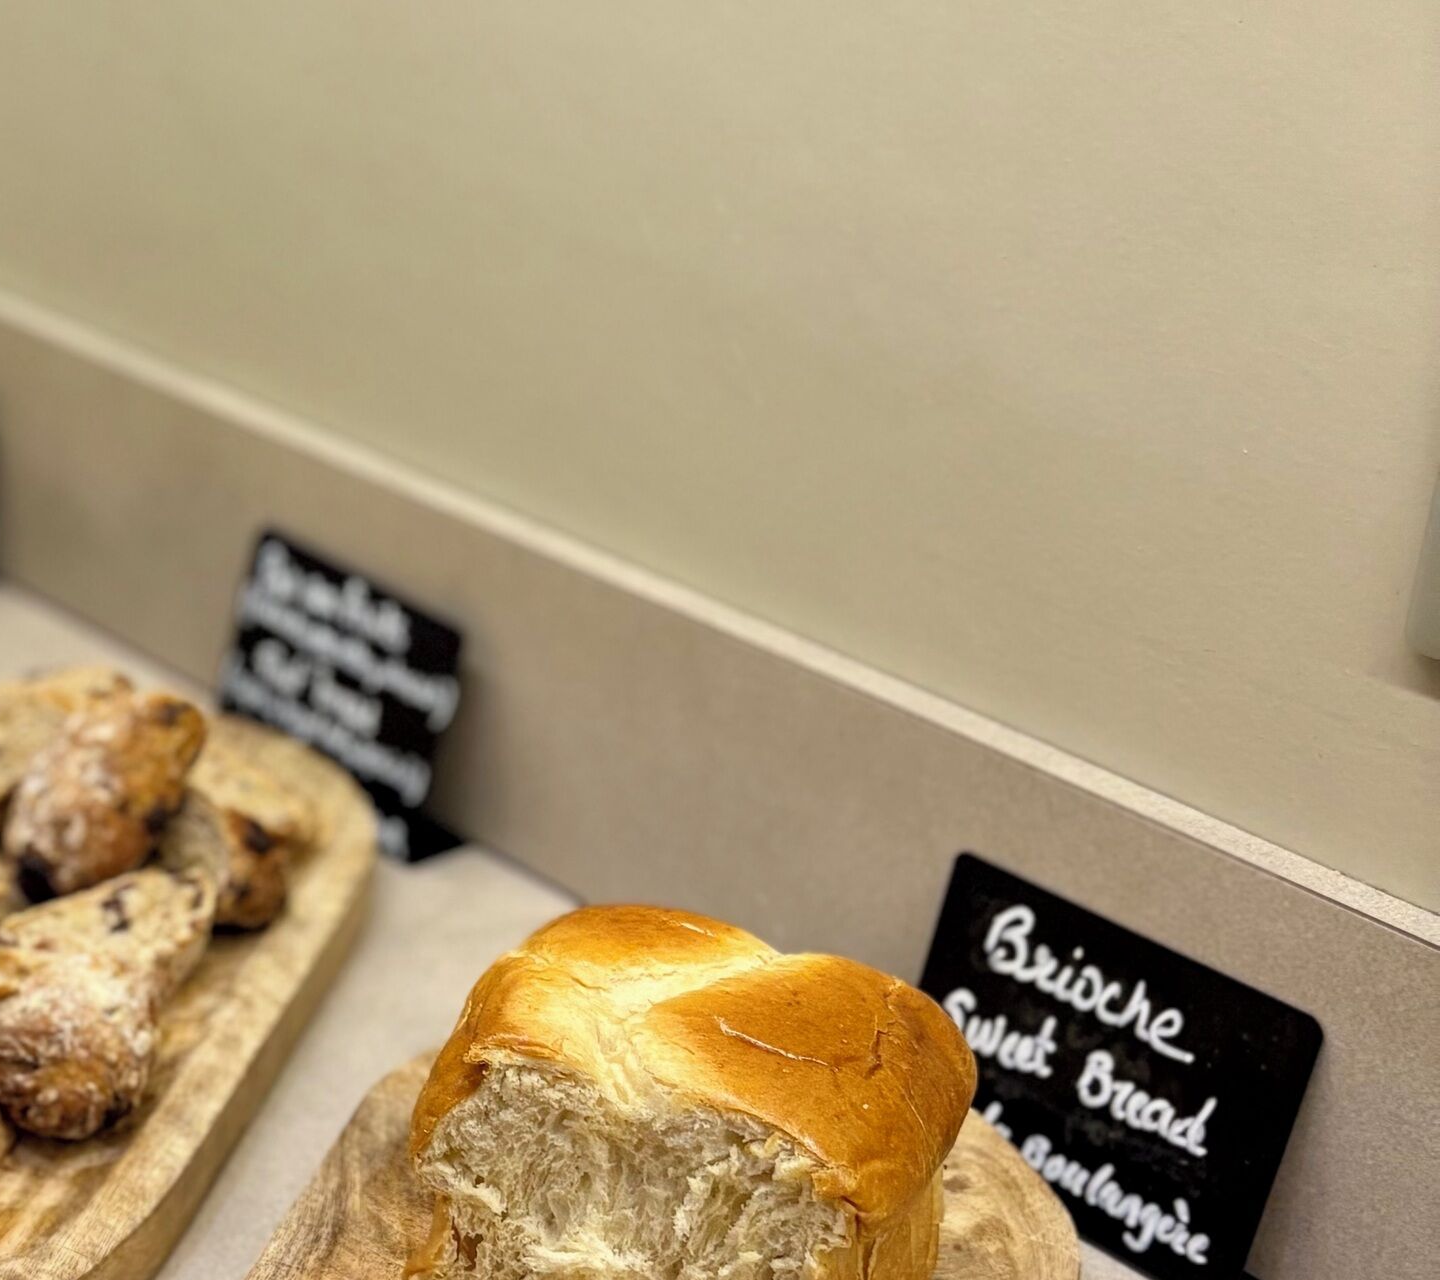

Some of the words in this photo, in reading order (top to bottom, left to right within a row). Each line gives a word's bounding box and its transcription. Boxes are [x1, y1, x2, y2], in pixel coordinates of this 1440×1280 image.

[983, 904, 1196, 1065] Brioche
[943, 987, 1058, 1079] Sweet
[1075, 1049, 1218, 1158] Bread
